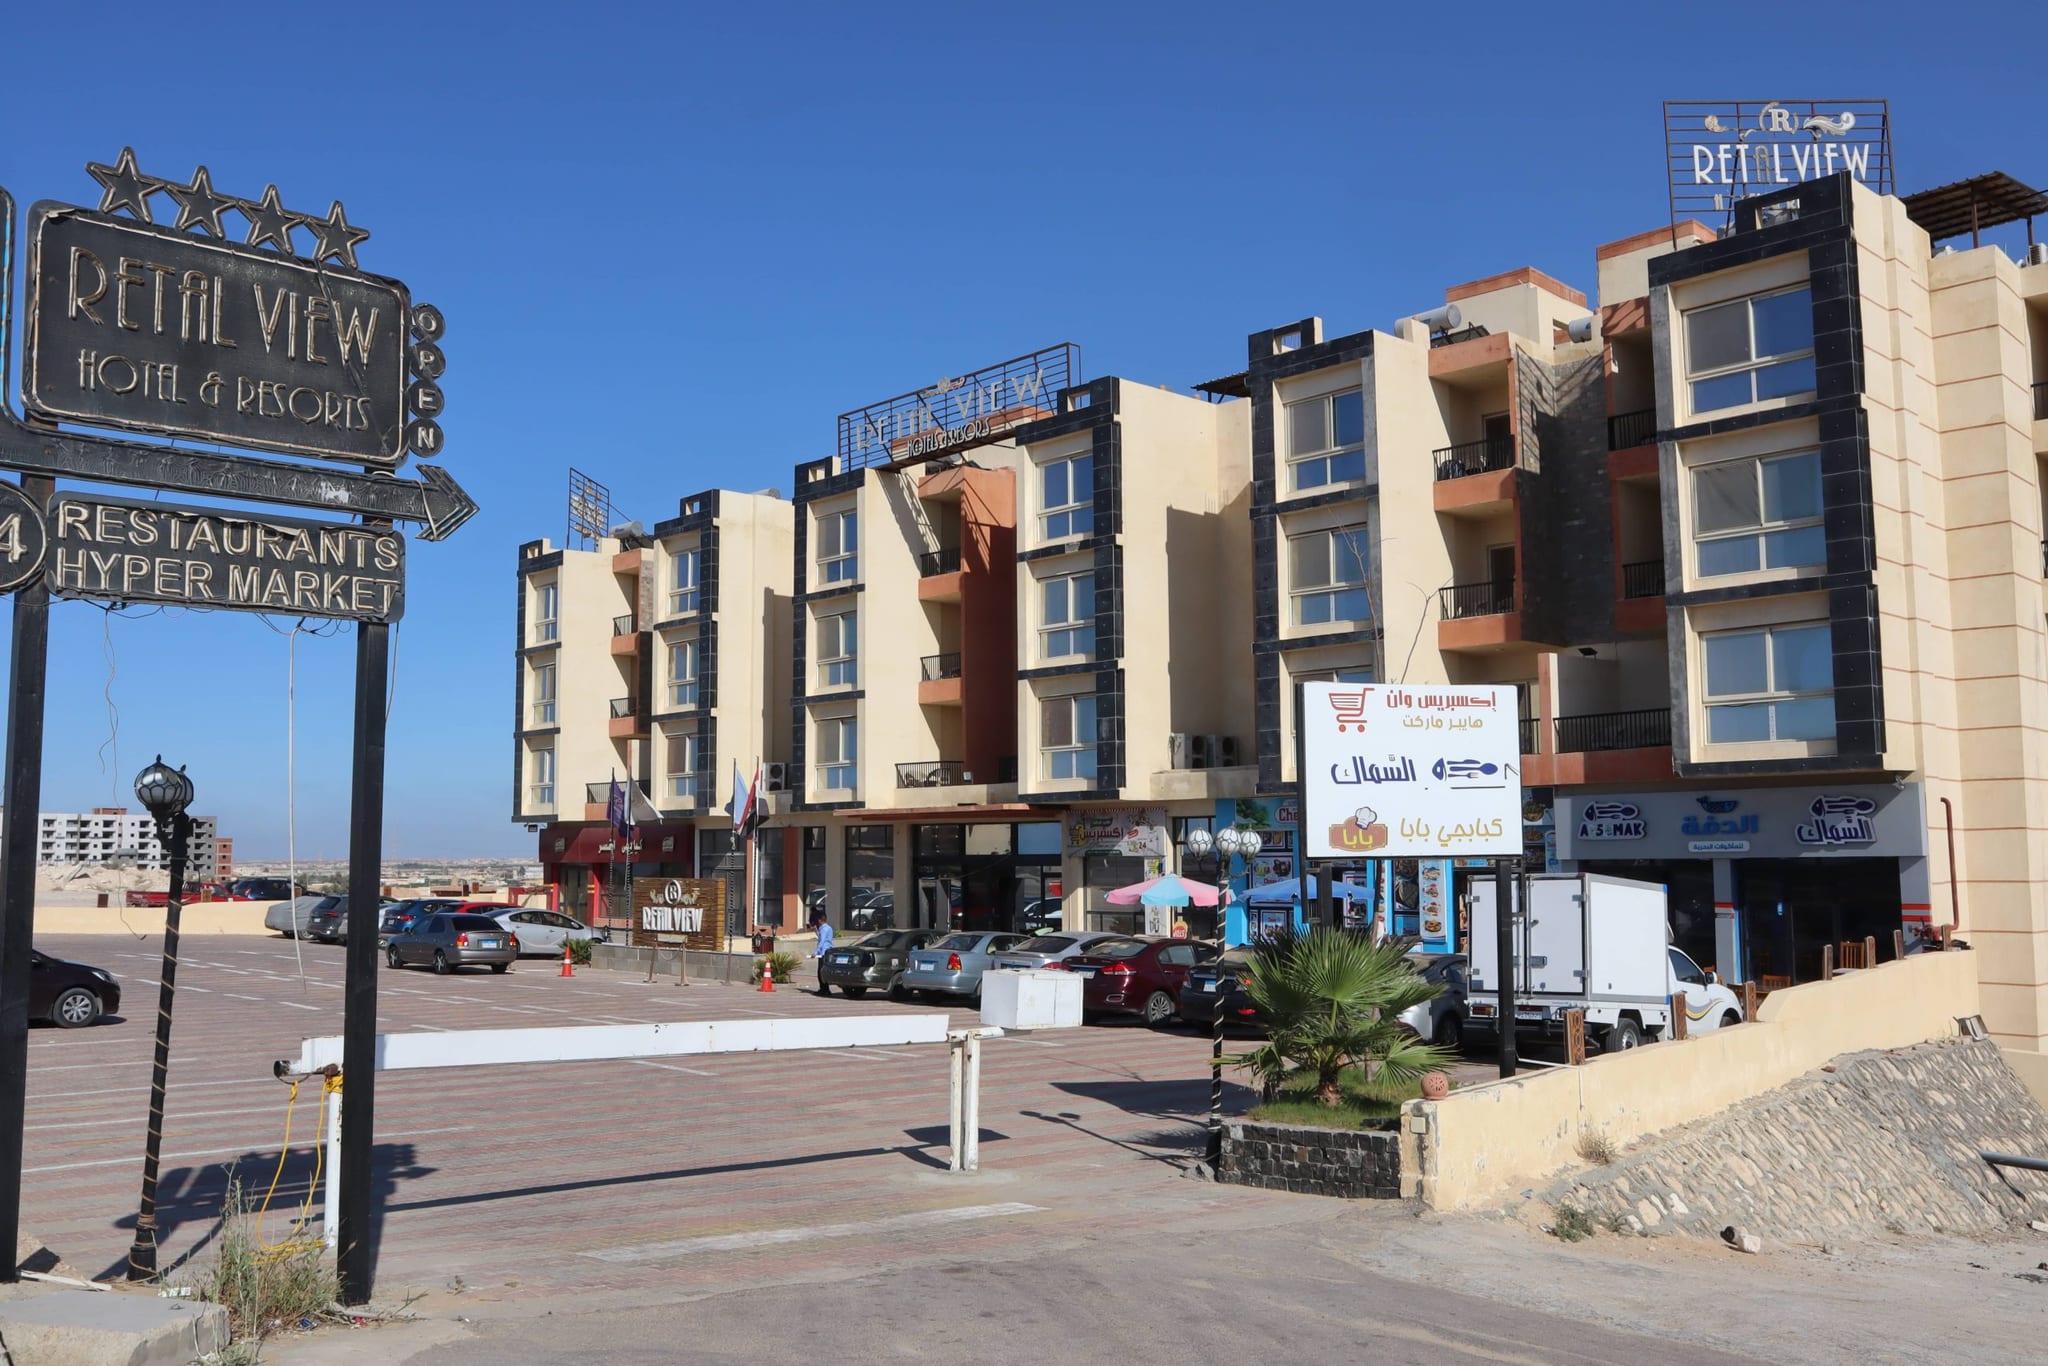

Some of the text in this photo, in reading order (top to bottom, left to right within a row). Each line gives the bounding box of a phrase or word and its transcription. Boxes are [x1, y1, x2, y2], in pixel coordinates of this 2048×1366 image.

[253, 282, 379, 371] VIEW
[79, 349, 371, 432] HOTEL & RESORTS
[57, 500, 399, 572] RESTAURANTS
[56, 547, 398, 614] HYPER MARKET
[1387, 689, 1497, 713] إكسبريس وان
[1402, 714, 1484, 732] هايبر ماركت
[1400, 818, 1431, 842] بابا
